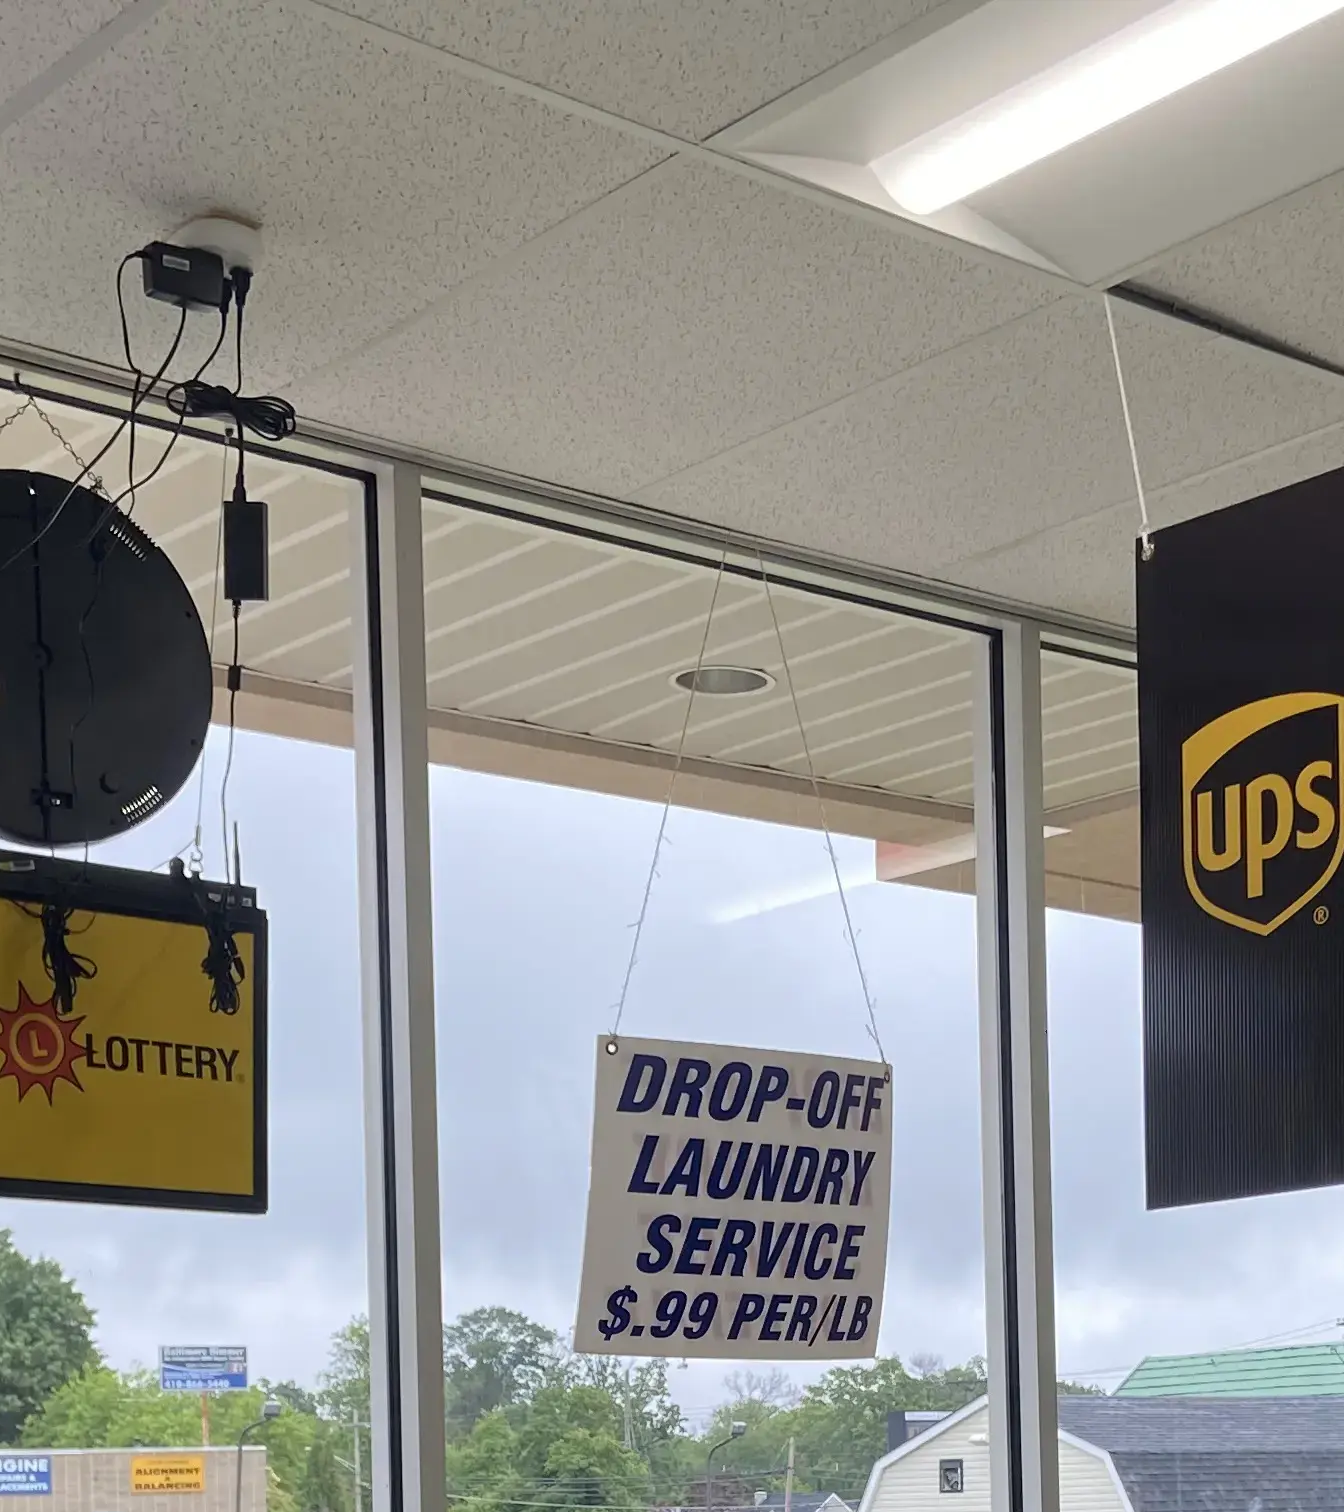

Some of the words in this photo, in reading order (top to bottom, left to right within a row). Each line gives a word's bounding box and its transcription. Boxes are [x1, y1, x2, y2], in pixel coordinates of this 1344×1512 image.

[1195, 759, 1336, 899] ups
[85, 1033, 240, 1083] LOTTERY
[616, 1053, 884, 1131] DROP-OFF
[627, 1135, 876, 1206] LAUNDRY
[636, 1214, 866, 1279] SERVICE
[598, 1284, 718, 1341] $.99
[727, 1293, 873, 1347] PER/LB
[134, 1482, 200, 1490] BALANCING
[136, 1467, 200, 1476] ALIGNMENT
